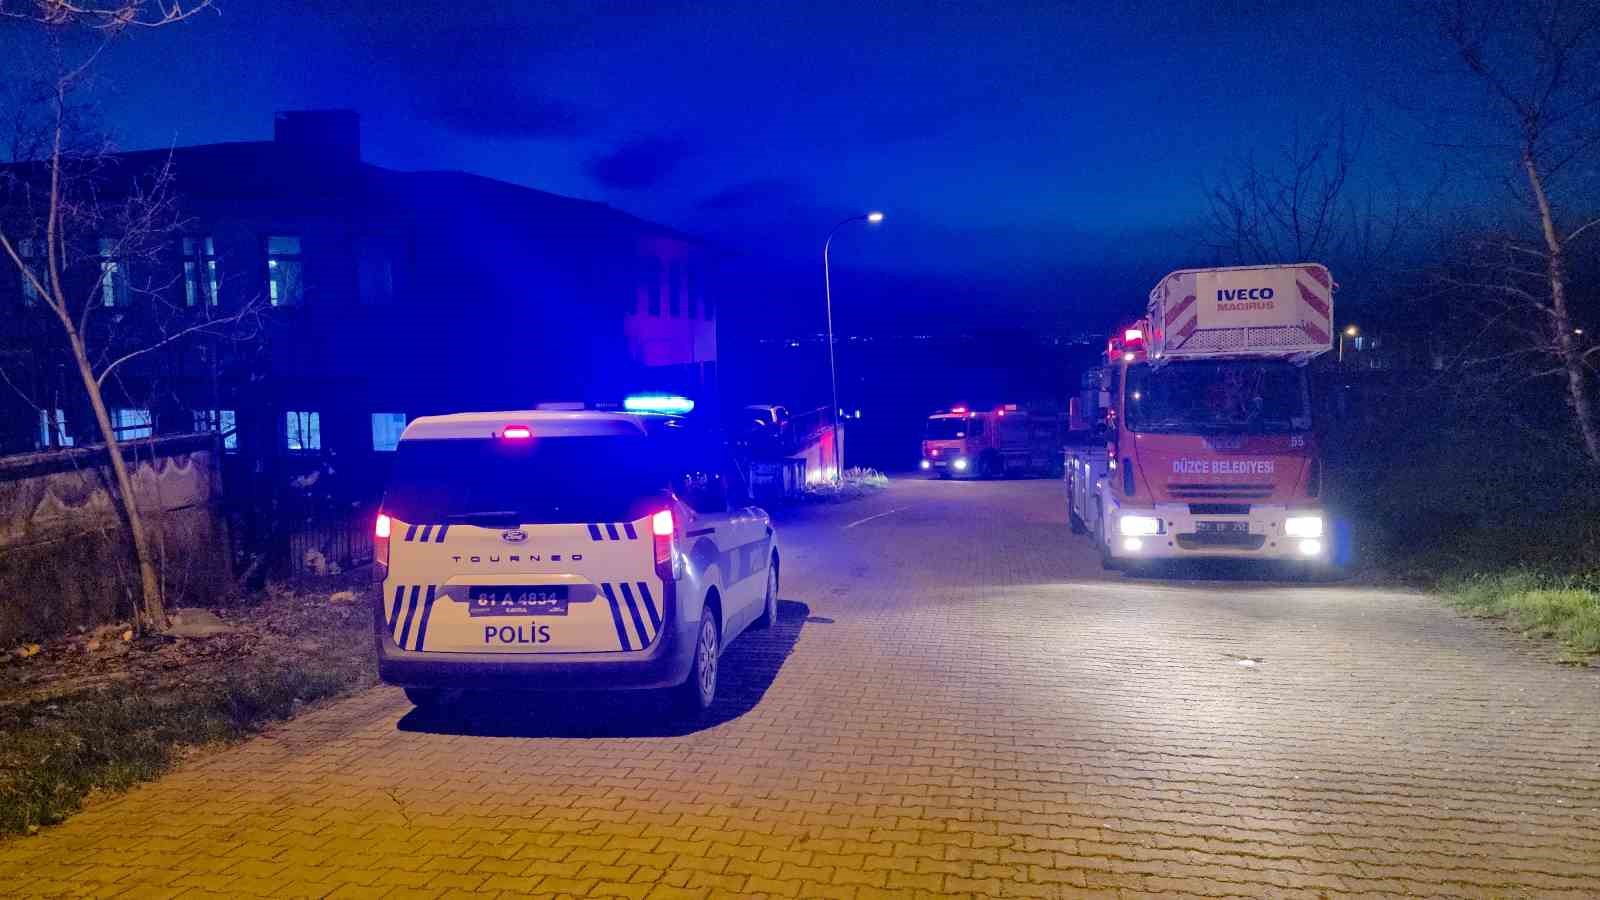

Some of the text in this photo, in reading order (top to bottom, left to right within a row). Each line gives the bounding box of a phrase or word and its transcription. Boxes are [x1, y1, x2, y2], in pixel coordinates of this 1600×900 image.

[1217, 287, 1274, 301] IVECO
[1216, 301, 1275, 311] MAGIRUS
[1173, 457, 1209, 474] DÜZCE
[452, 554, 583, 563] TOURNEO
[501, 592, 515, 606] A
[518, 592, 558, 606] 4834
[485, 620, 551, 644] POLİS
